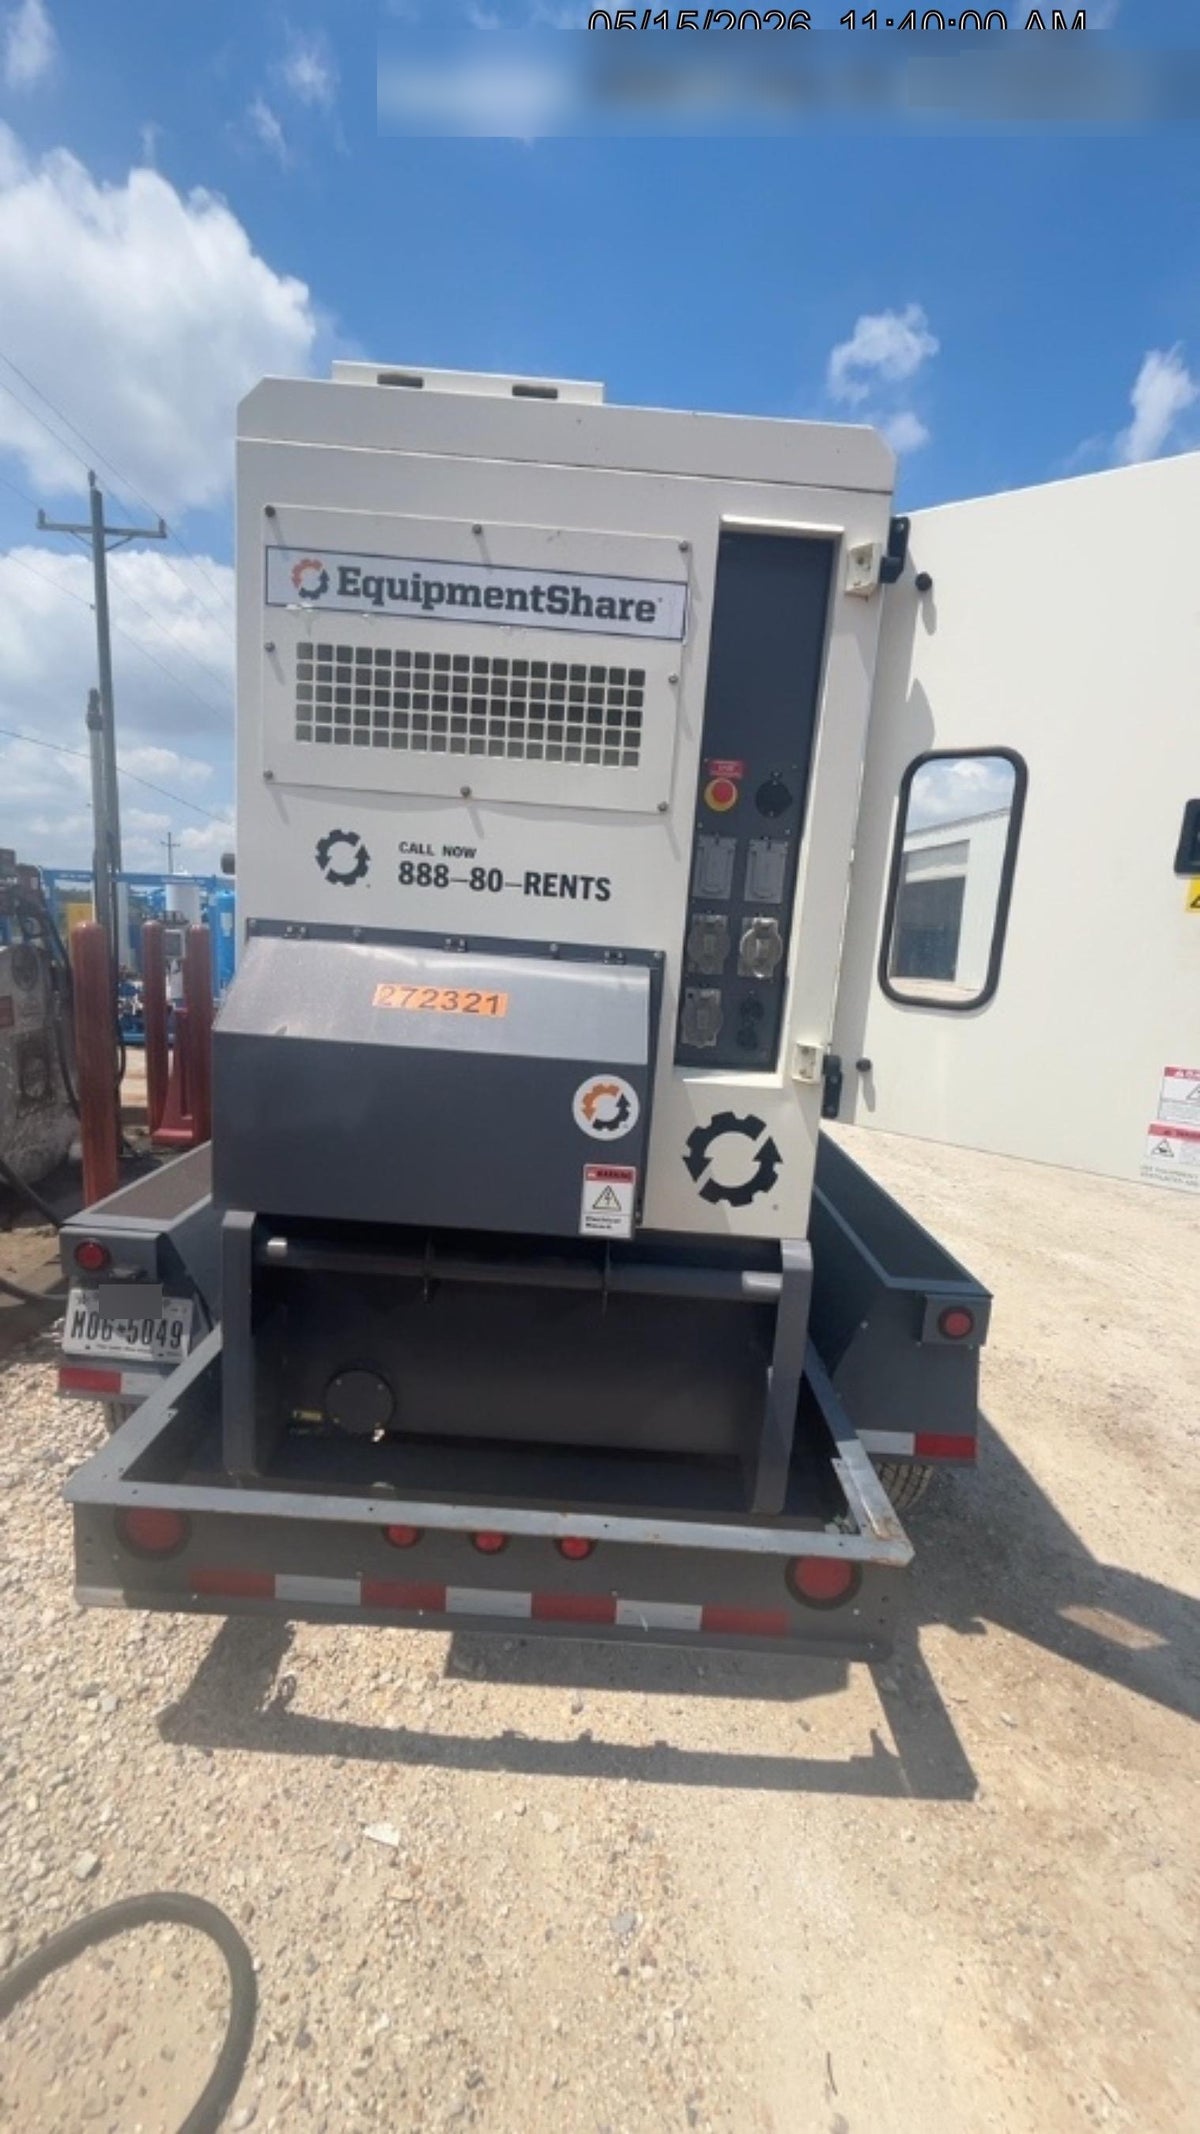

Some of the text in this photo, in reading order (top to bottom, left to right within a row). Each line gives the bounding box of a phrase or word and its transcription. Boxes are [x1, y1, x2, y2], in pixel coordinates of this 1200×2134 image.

[337, 566, 656, 623] EquipmentShare
[398, 841, 477, 859] CALL NOW
[379, 985, 500, 1016] 272321
